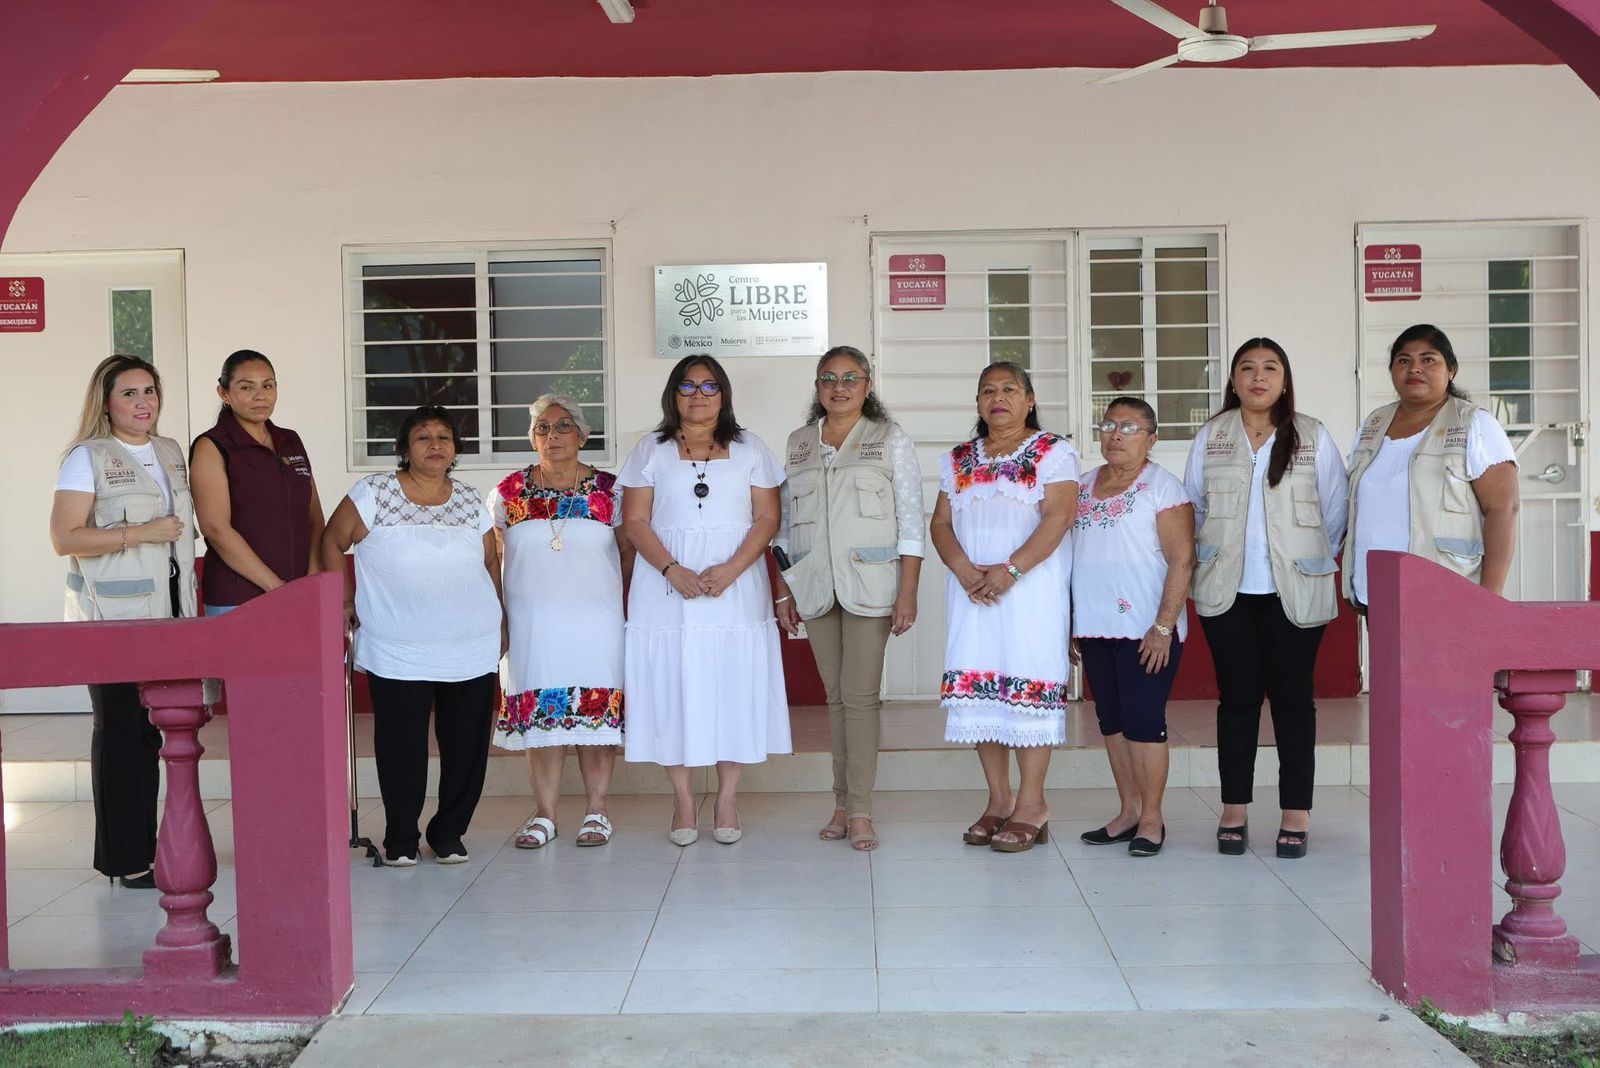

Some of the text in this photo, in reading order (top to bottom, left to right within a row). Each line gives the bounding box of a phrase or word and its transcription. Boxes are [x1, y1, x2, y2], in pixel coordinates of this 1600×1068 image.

[729, 275, 759, 283] Centro
[1372, 270, 1414, 279] YUCATÁN
[896, 280, 938, 289] YUCATÁN
[729, 285, 808, 305] LIBRE
[730, 308, 747, 317] para
[736, 307, 808, 323] las Mujeres
[684, 339, 713, 347] México
[720, 337, 747, 345] Mujeres
